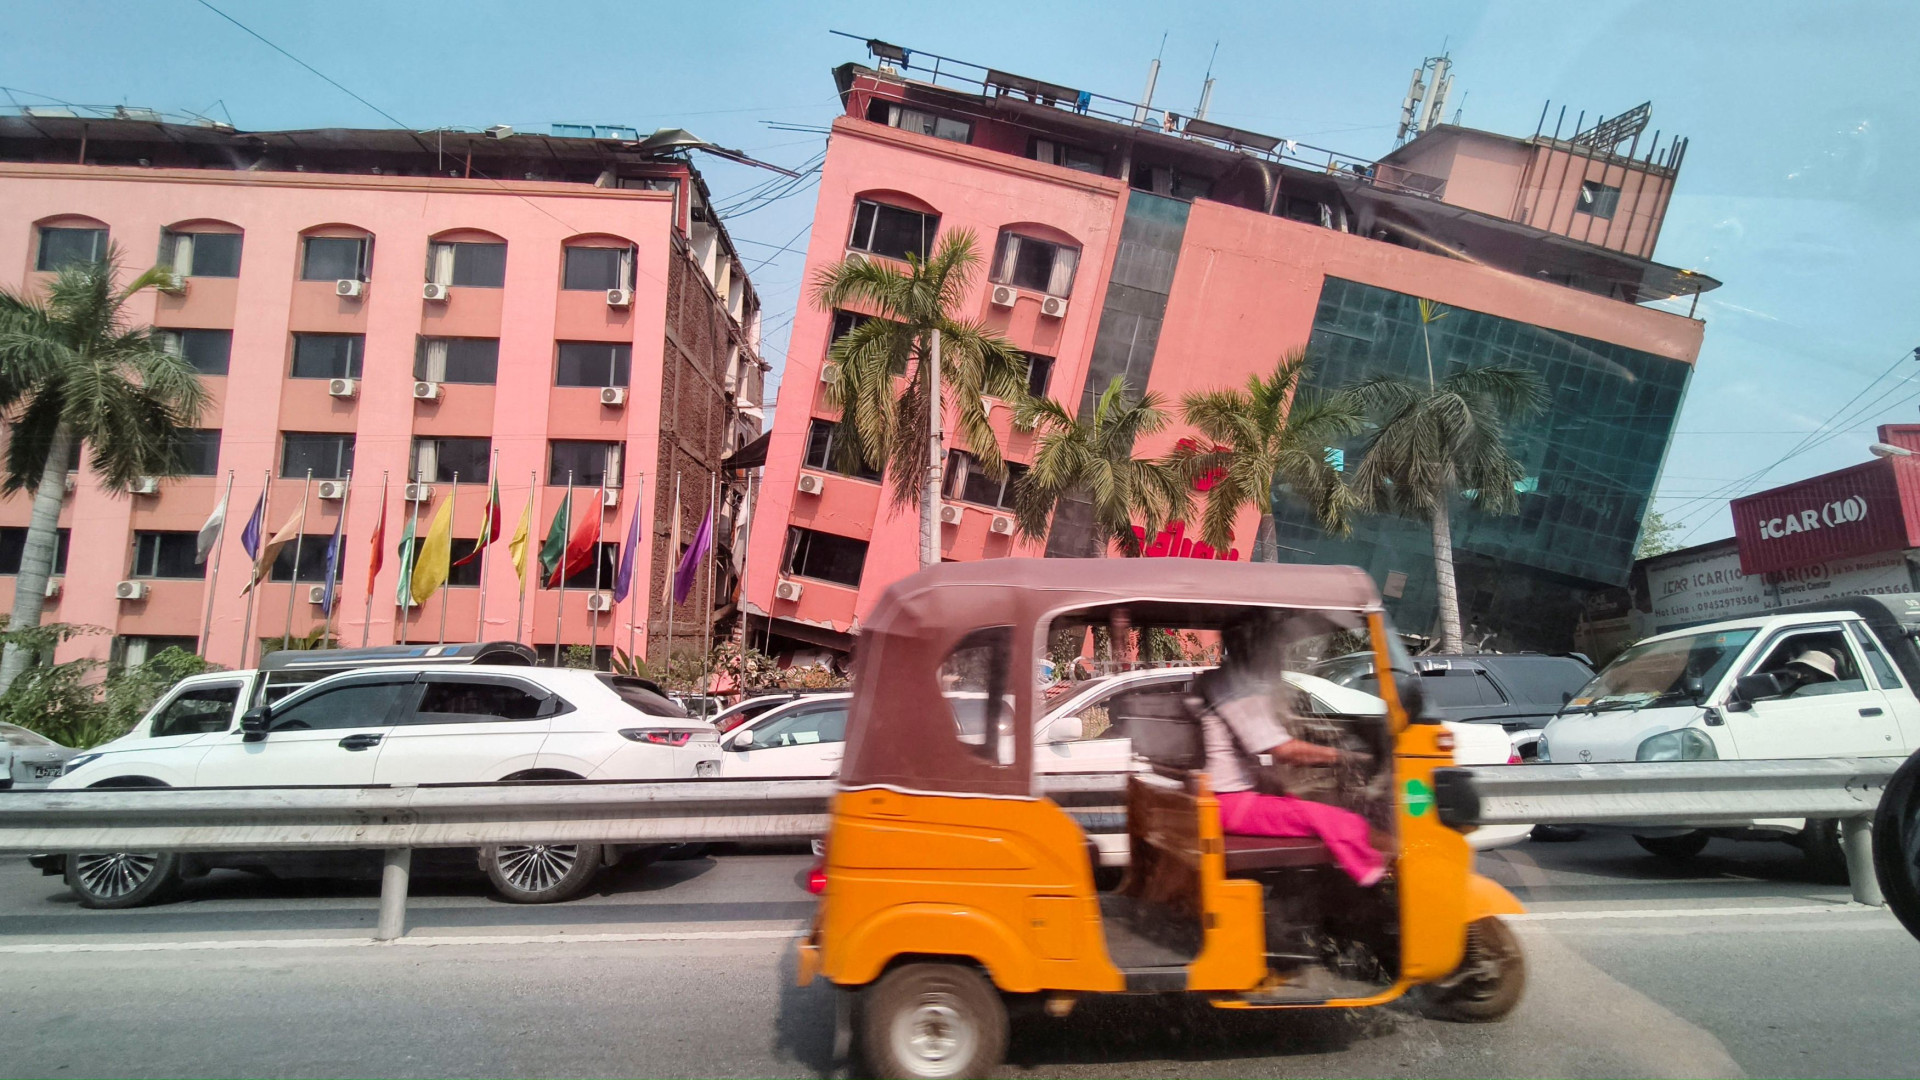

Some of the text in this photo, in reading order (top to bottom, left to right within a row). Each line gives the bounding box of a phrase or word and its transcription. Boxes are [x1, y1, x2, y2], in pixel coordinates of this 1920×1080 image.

[1759, 495, 1868, 540] iCAR (10)
[1671, 604, 1690, 615] Line
